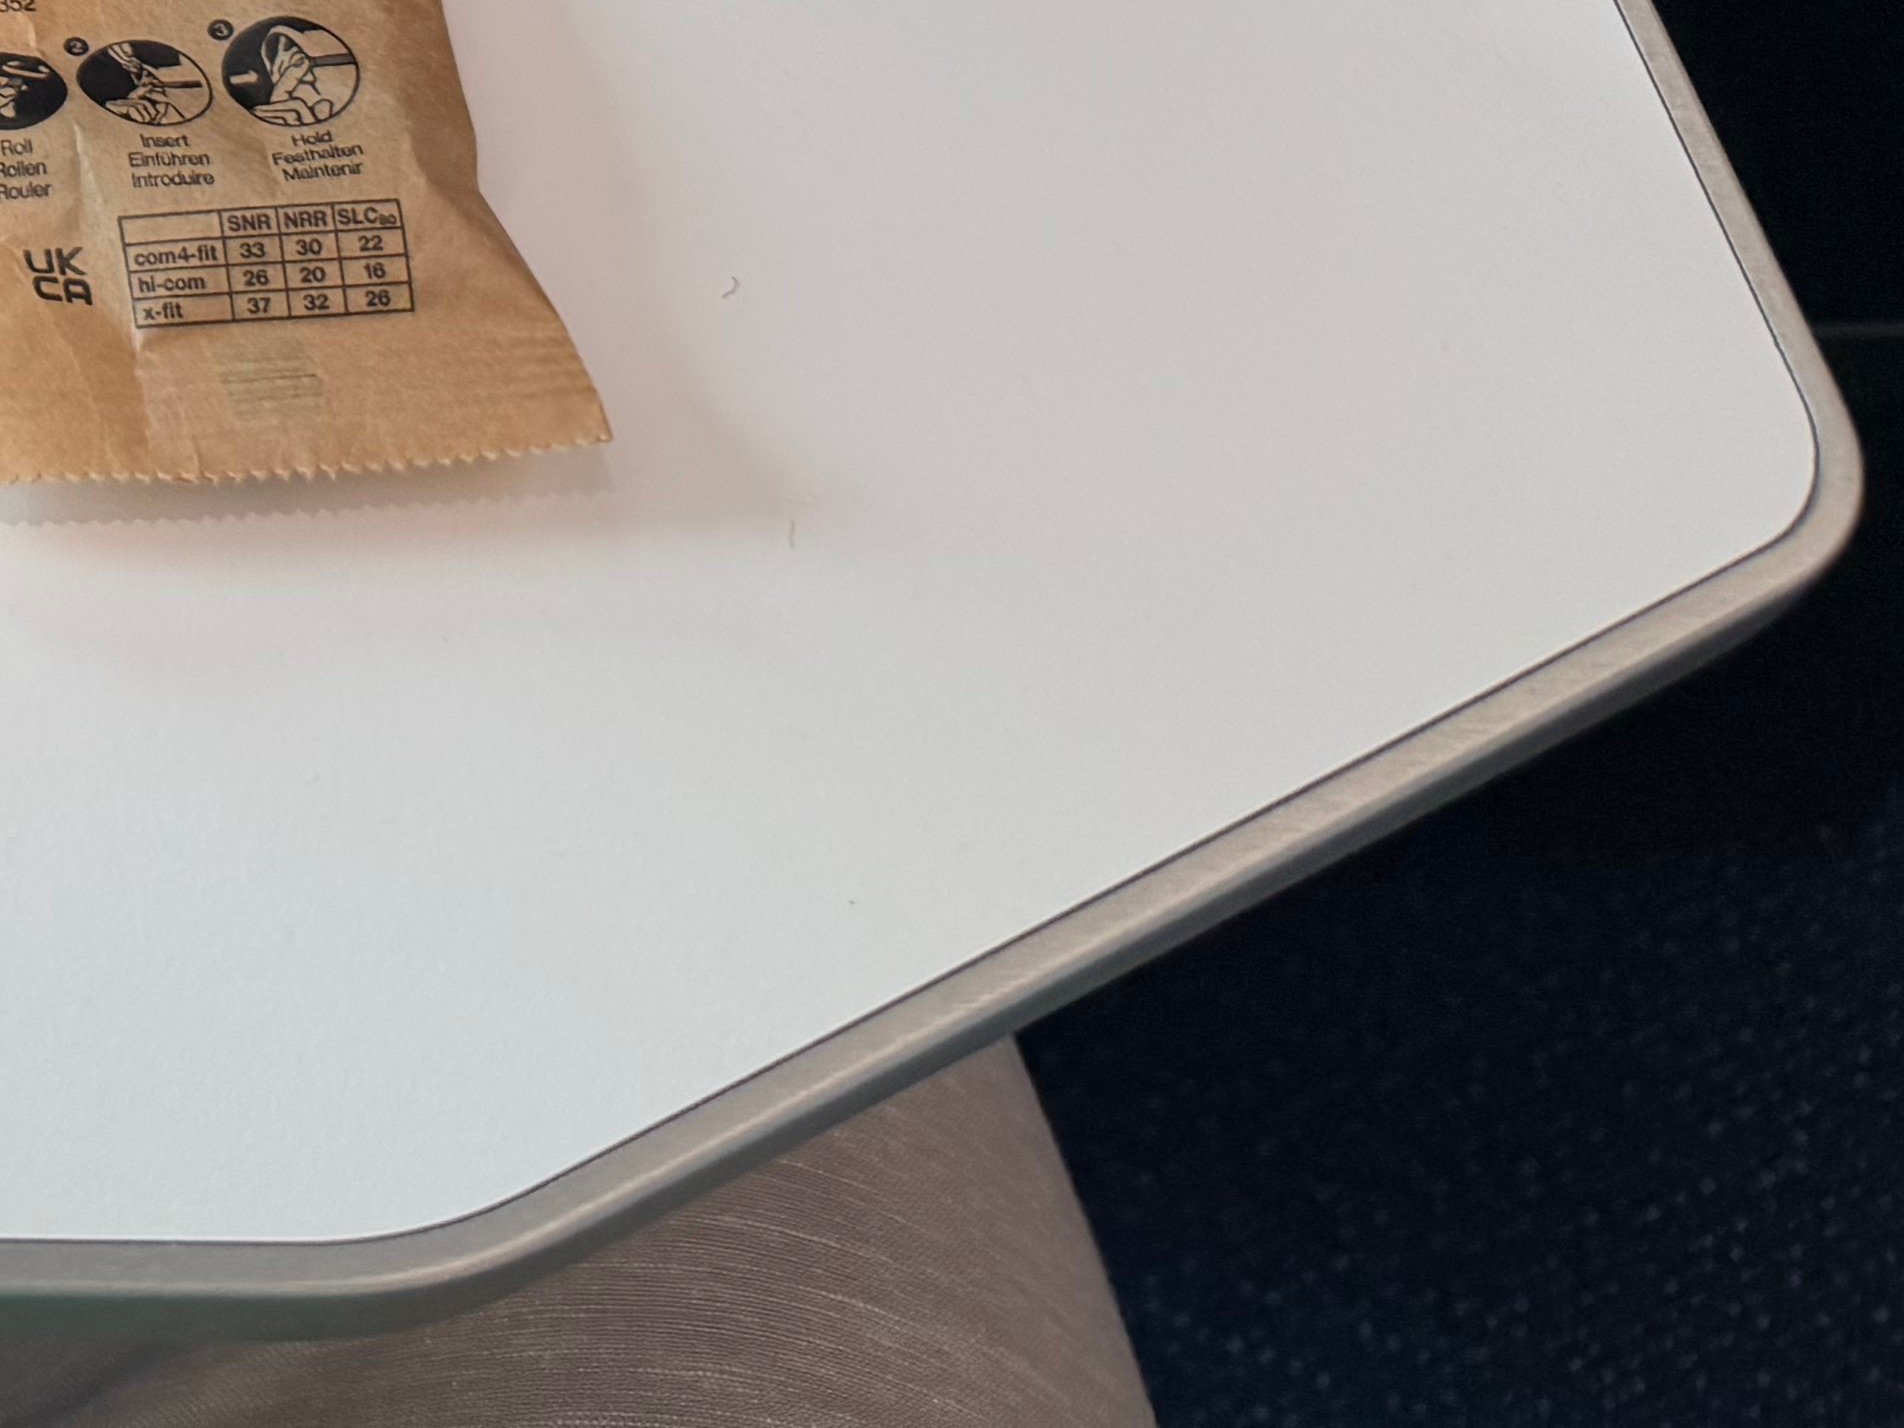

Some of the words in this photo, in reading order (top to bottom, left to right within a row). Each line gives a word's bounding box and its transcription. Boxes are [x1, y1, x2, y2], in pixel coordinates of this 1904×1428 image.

[0, 139, 33, 157] Roll
[140, 132, 190, 149] Insert
[292, 130, 333, 147] Hold
[128, 150, 211, 169] Einführen
[272, 142, 364, 167] Festhalten
[131, 170, 215, 189] Introduire
[282, 159, 363, 183] Maintenir
[228, 212, 272, 233] SNR
[283, 209, 328, 230] NRR
[23, 245, 88, 277] UK
[133, 246, 220, 269] com4-fit
[239, 241, 267, 259] 33
[295, 238, 324, 256] 30
[358, 234, 384, 252] 22
[138, 274, 207, 293] hi-com
[243, 269, 270, 286] 26
[299, 265, 327, 283] 20
[363, 262, 387, 280] 16
[32, 276, 94, 307] CA
[142, 301, 184, 321] x-fit
[246, 296, 272, 314] 37
[302, 293, 330, 311] 32
[364, 289, 391, 307] 26
